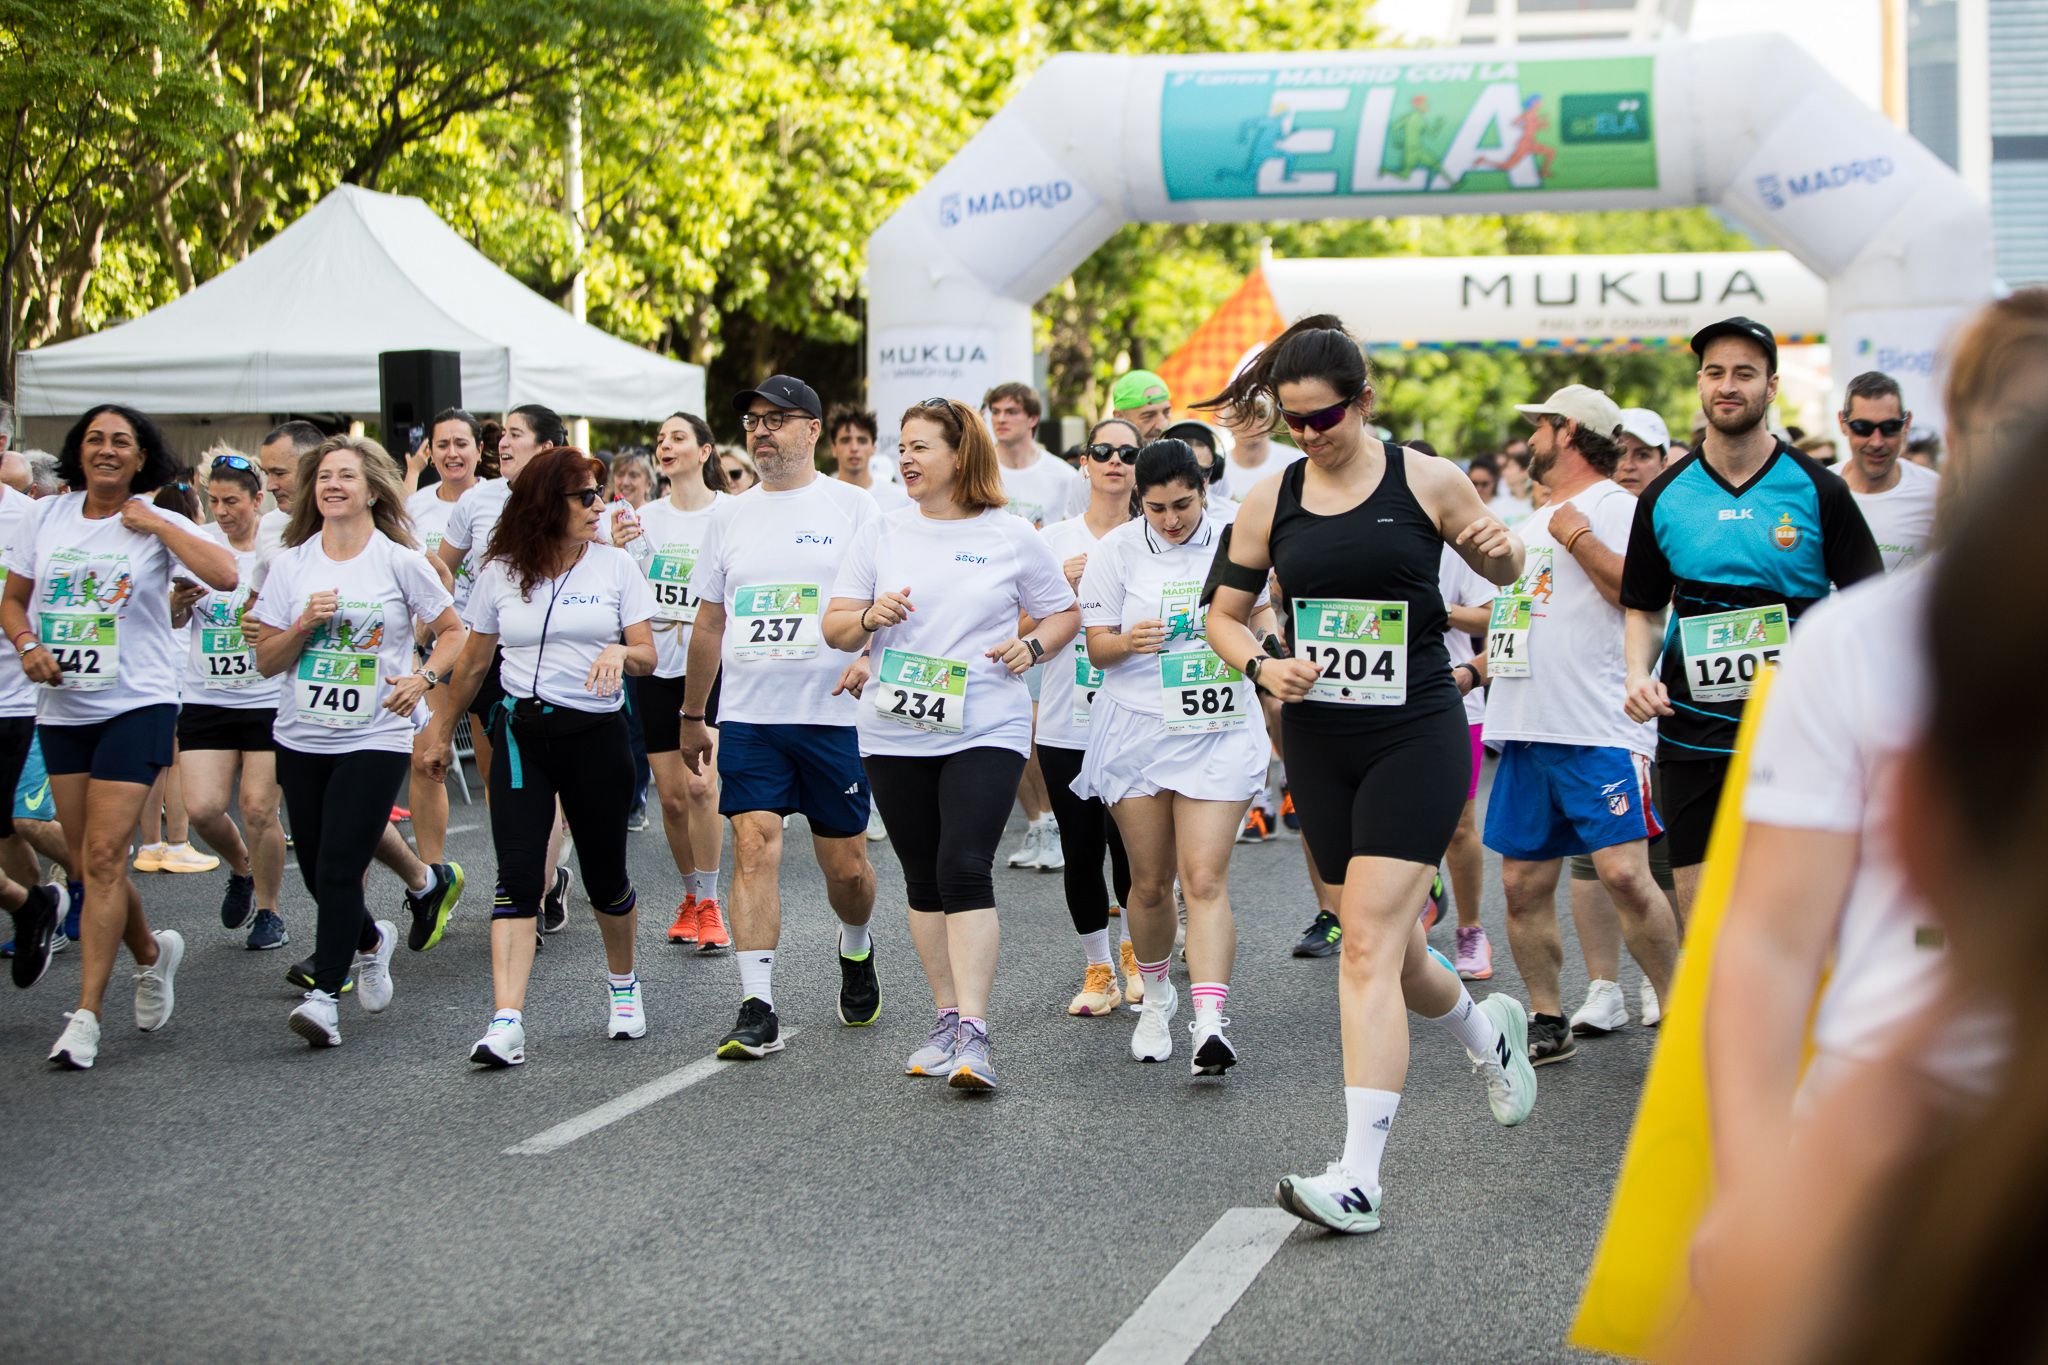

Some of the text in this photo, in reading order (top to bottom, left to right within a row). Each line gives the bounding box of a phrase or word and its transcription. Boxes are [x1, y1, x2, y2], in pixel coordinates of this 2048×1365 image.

[1275, 68, 1400, 87] MADRID
[1405, 63, 1474, 82] CON
[1478, 62, 1520, 80] LA
[1257, 83, 1542, 195] ELA
[1788, 155, 1894, 195] MADRID
[967, 181, 1073, 216] MADRID
[1460, 270, 1766, 306] MUKUA
[879, 344, 987, 365] MUKUA
[1717, 508, 1755, 521] BLK
[751, 590, 801, 613] ELA
[1162, 586, 1204, 596] MADRID
[51, 620, 99, 642] ELA
[750, 617, 802, 642] 237
[1317, 609, 1381, 640] ELA
[1706, 618, 1767, 650] ELA
[52, 648, 101, 674] 742
[208, 655, 256, 676] 123
[311, 658, 360, 681] ELA
[897, 660, 951, 690] ELA
[1181, 656, 1232, 684] ELA
[308, 684, 360, 713] 740
[890, 690, 946, 723] 234
[1181, 686, 1236, 717] 582
